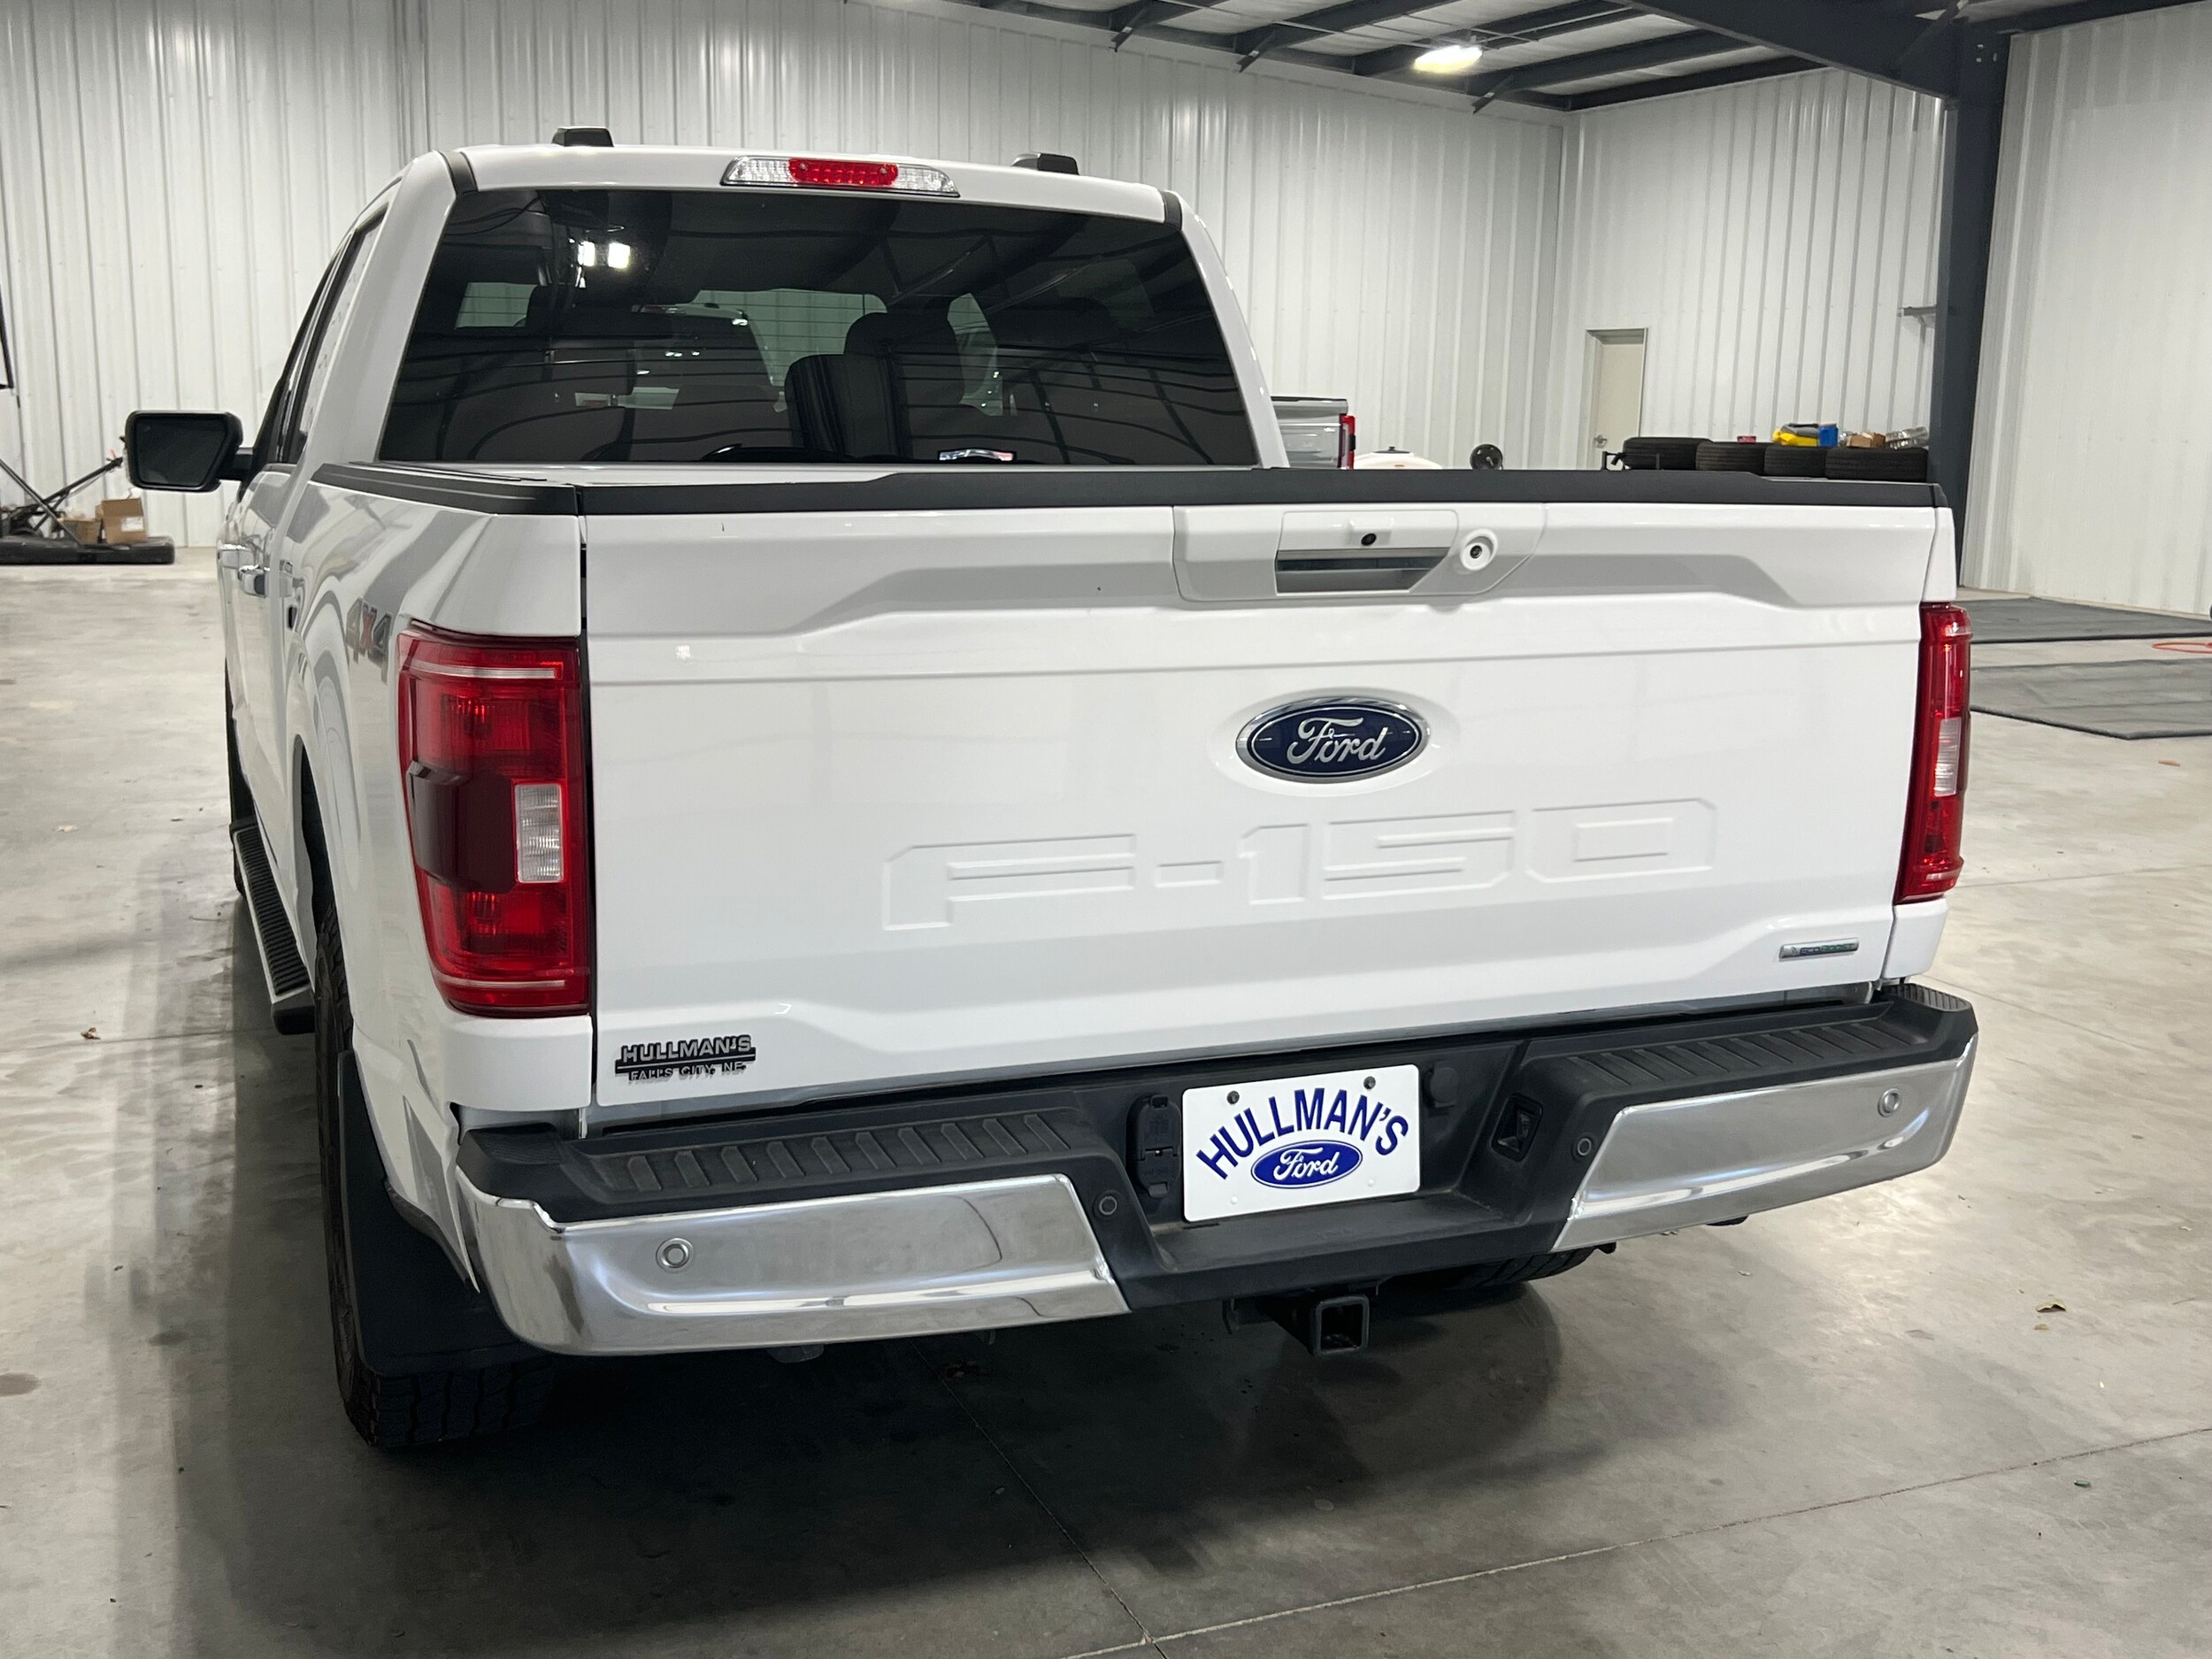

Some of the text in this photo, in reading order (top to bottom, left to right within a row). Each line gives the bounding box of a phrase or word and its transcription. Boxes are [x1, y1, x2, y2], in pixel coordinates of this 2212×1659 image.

[1286, 717, 1389, 764] Ford
[882, 798, 1717, 930] F-150
[621, 1034, 752, 1063] HULLMAN'S
[630, 1068, 673, 1080] FALLS
[1196, 1087, 1409, 1179] HULLMAN'S
[1273, 1147, 1340, 1180] Ford
